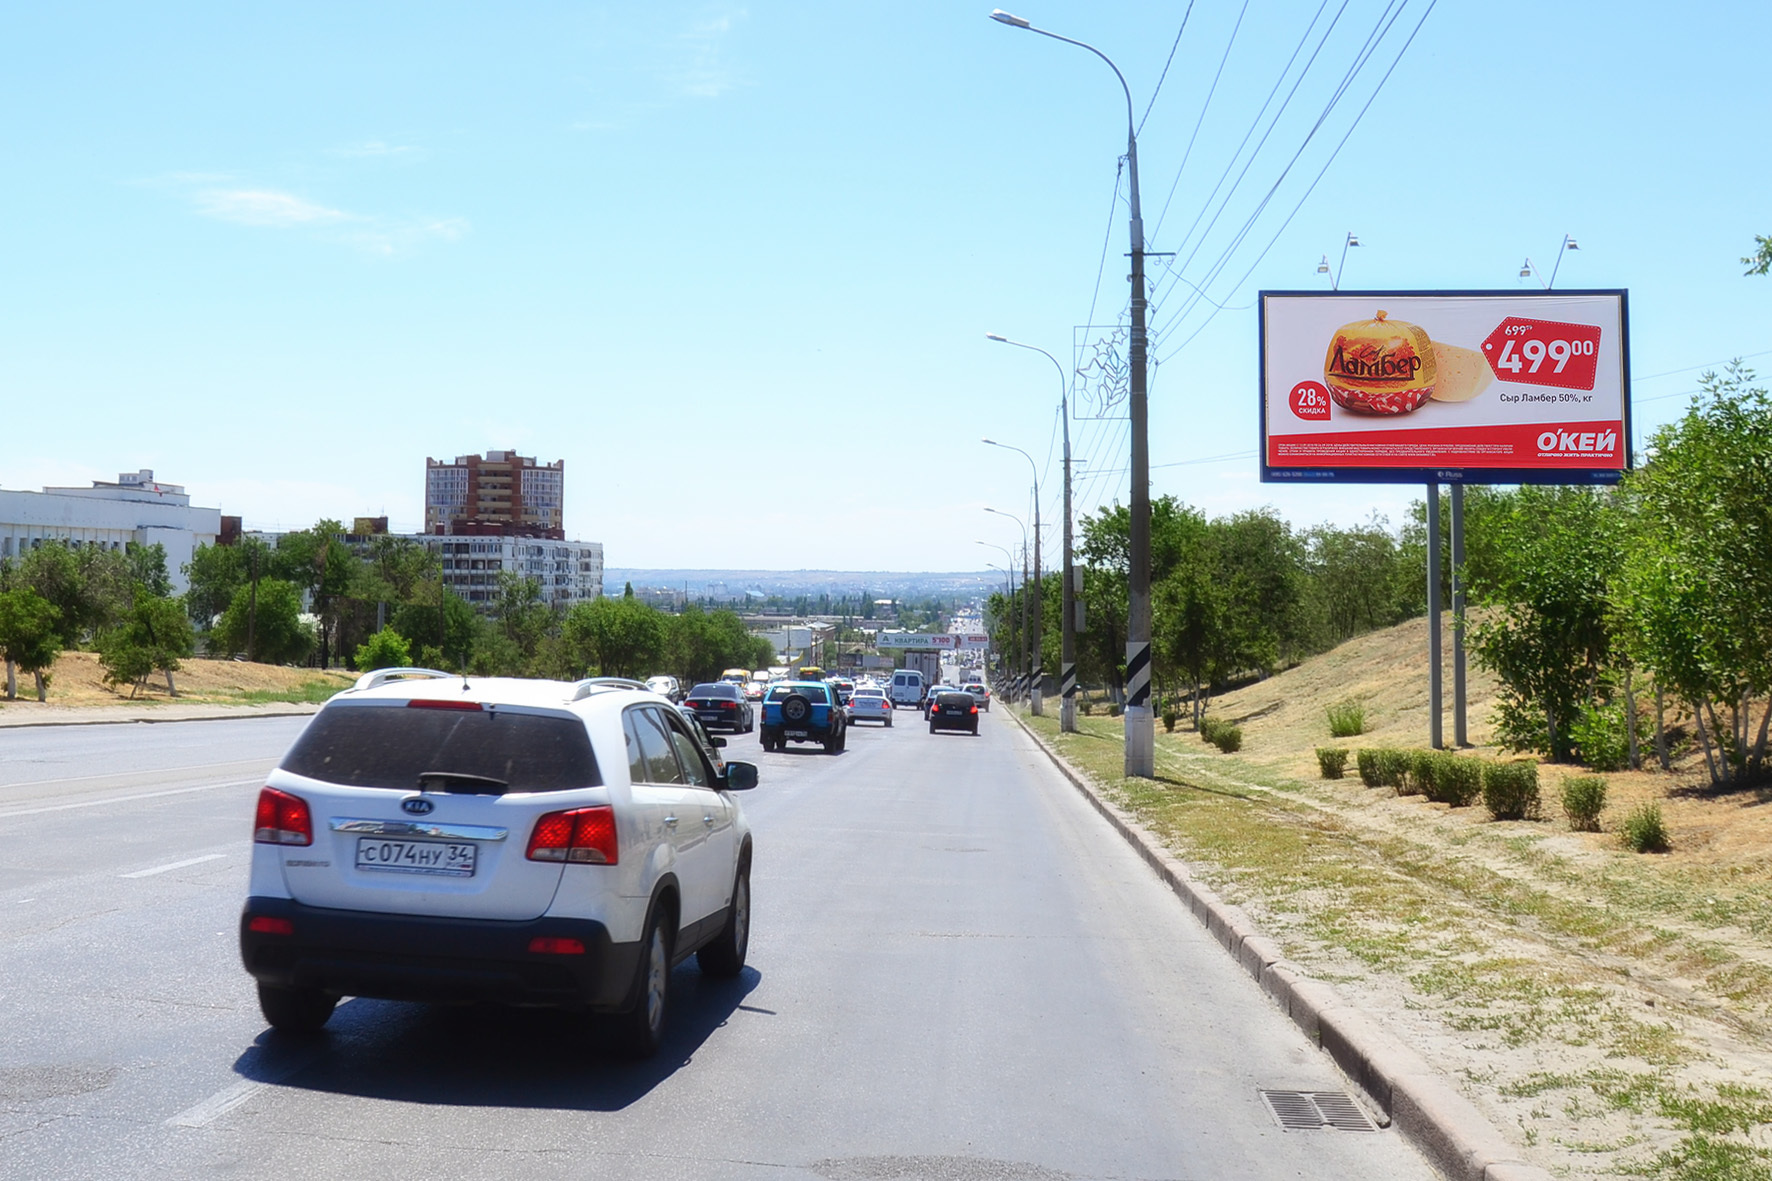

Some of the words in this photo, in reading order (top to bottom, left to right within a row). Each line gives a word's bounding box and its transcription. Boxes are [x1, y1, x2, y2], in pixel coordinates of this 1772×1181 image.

[1328, 345, 1421, 379] Ламбер
[1297, 388, 1327, 407] 28%
[1500, 393, 1520, 404] Сыр
[1521, 393, 1557, 404] Ламбер
[1559, 393, 1581, 403] 50%,
[895, 637, 929, 645] КВАРТИРА
[405, 800, 430, 812] KIA
